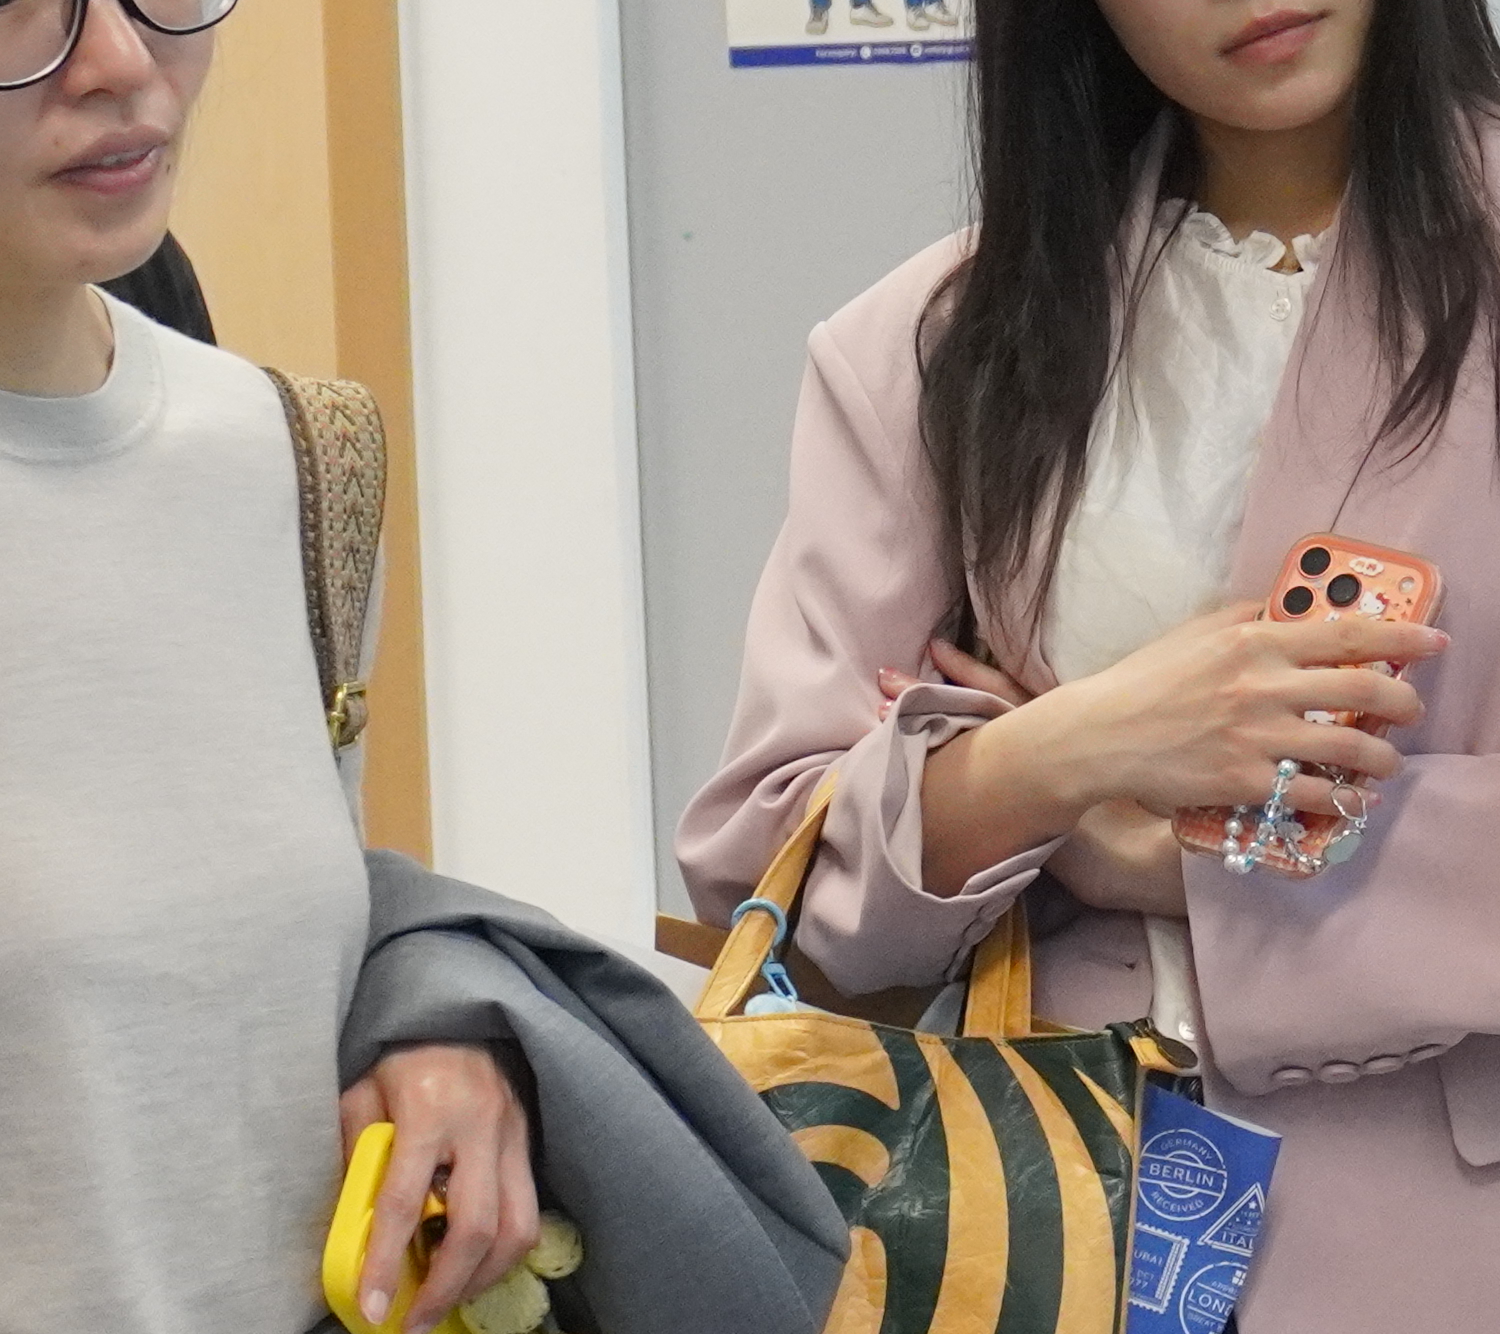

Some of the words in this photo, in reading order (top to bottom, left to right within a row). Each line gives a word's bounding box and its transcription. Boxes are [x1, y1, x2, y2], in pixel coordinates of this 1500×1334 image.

[1160, 1138, 1212, 1160] GERMANY
[1148, 1162, 1215, 1187] BERLIN
[1151, 1190, 1205, 1213] RECEIVED
